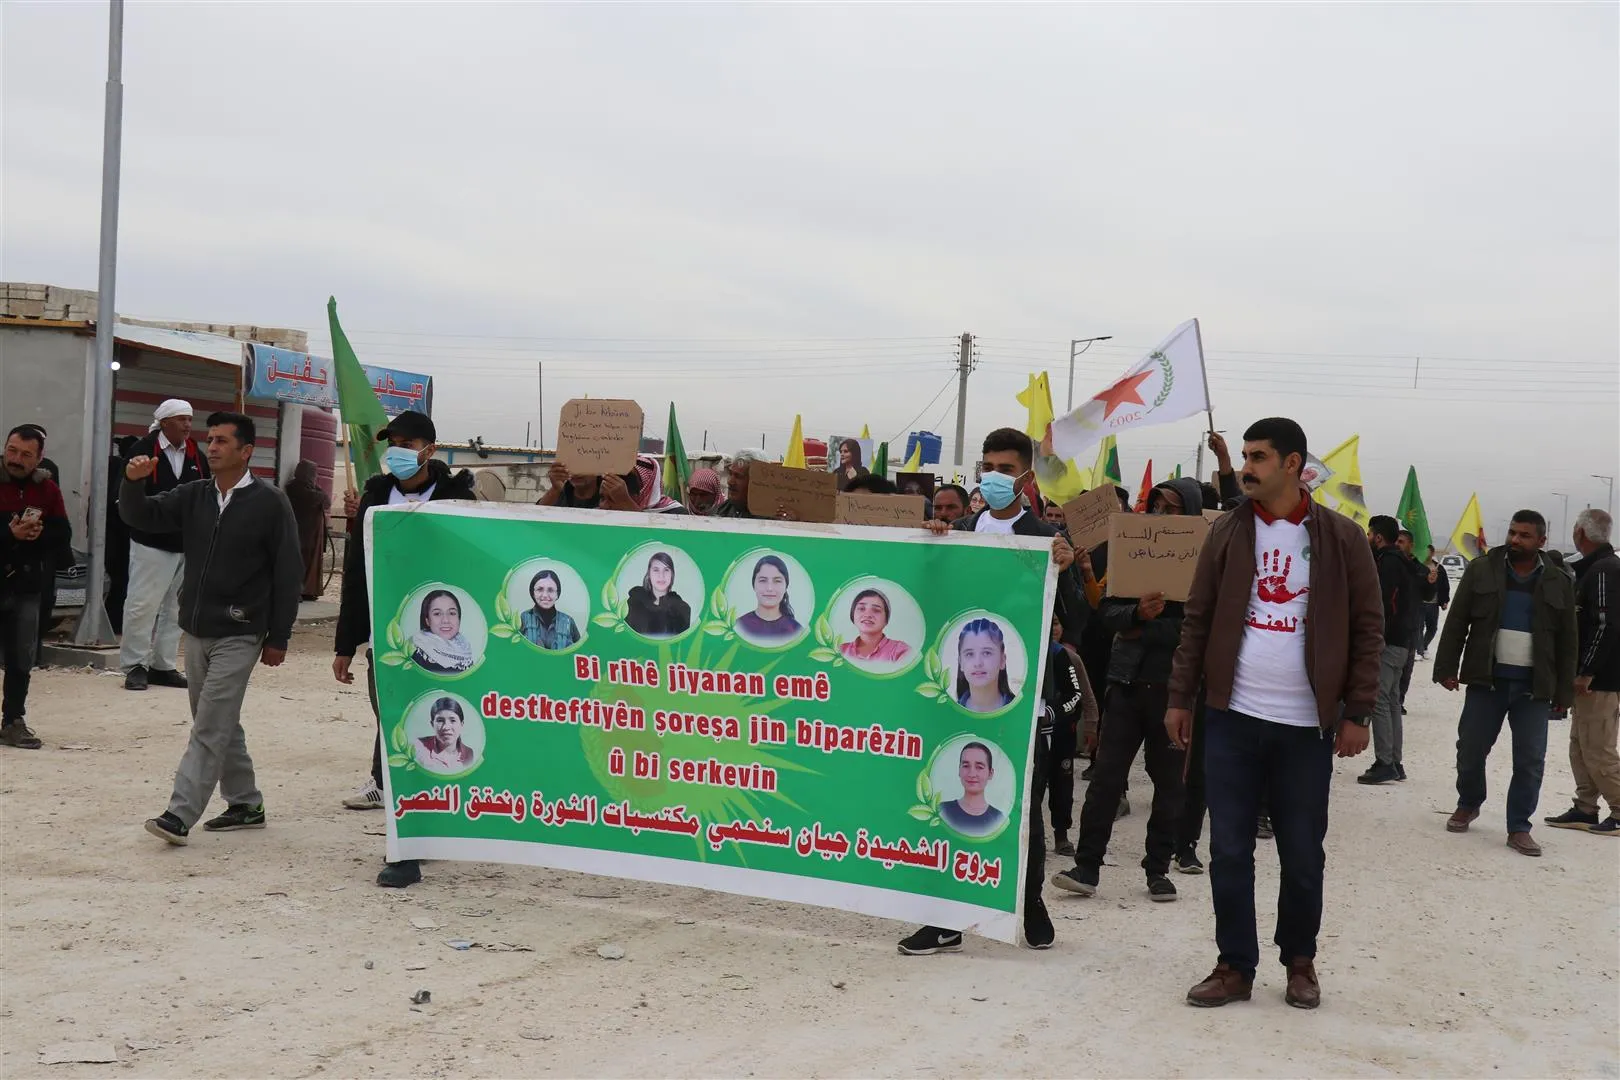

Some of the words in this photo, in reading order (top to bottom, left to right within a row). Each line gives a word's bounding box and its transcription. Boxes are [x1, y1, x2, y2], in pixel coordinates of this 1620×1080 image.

[364, 370, 424, 405] صيدلي
[575, 655, 600, 681] Bi
[608, 659, 659, 688] rihê
[668, 664, 765, 697] jîyanan
[774, 672, 830, 700] emê
[481, 692, 645, 731] destkeftiyên
[654, 710, 740, 743] şoreşa
[750, 715, 786, 746] jin
[796, 719, 923, 759] biparêzin
[609, 749, 625, 777] û
[634, 751, 660, 780] bi
[668, 759, 777, 792] serkevin
[395, 785, 460, 818] النصر
[466, 787, 527, 821] ونحقق
[531, 793, 597, 825] الثورة
[602, 801, 701, 835] مكتسبات
[706, 818, 792, 850] سنحمي
[797, 822, 850, 860] جيان
[855, 828, 949, 870] الشهيدة
[953, 849, 1002, 887] بروح
